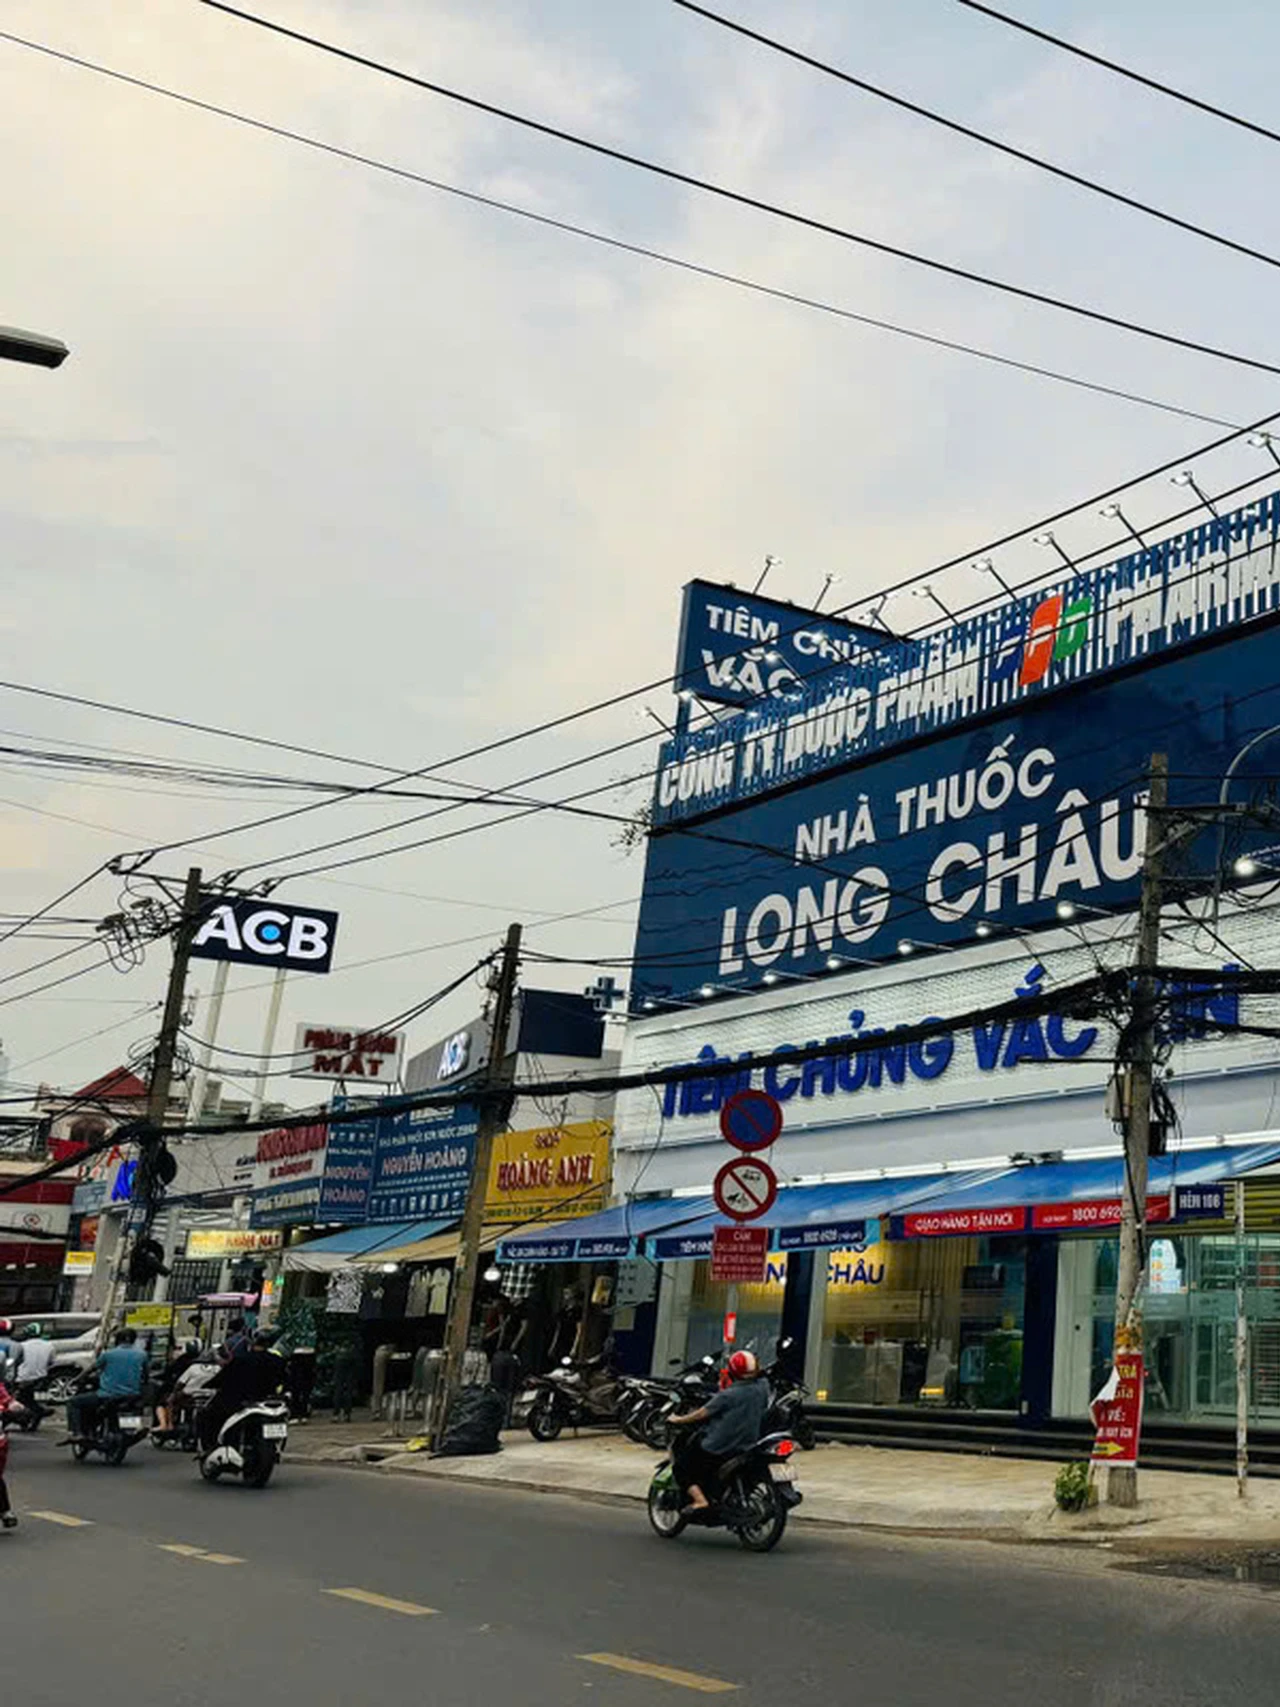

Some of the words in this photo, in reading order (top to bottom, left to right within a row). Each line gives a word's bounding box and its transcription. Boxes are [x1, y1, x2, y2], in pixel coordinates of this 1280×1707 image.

[705, 604, 780, 645] TIÊM
[993, 602, 1089, 678] FPT
[794, 793, 876, 866] NHÀ
[895, 734, 1056, 834] THUỐC
[717, 866, 891, 975] LONG
[925, 788, 1151, 924] CHÂU
[191, 904, 329, 960] ACB
[763, 1010, 955, 1101] CHỦNG
[1099, 1205, 1124, 1219] 692
